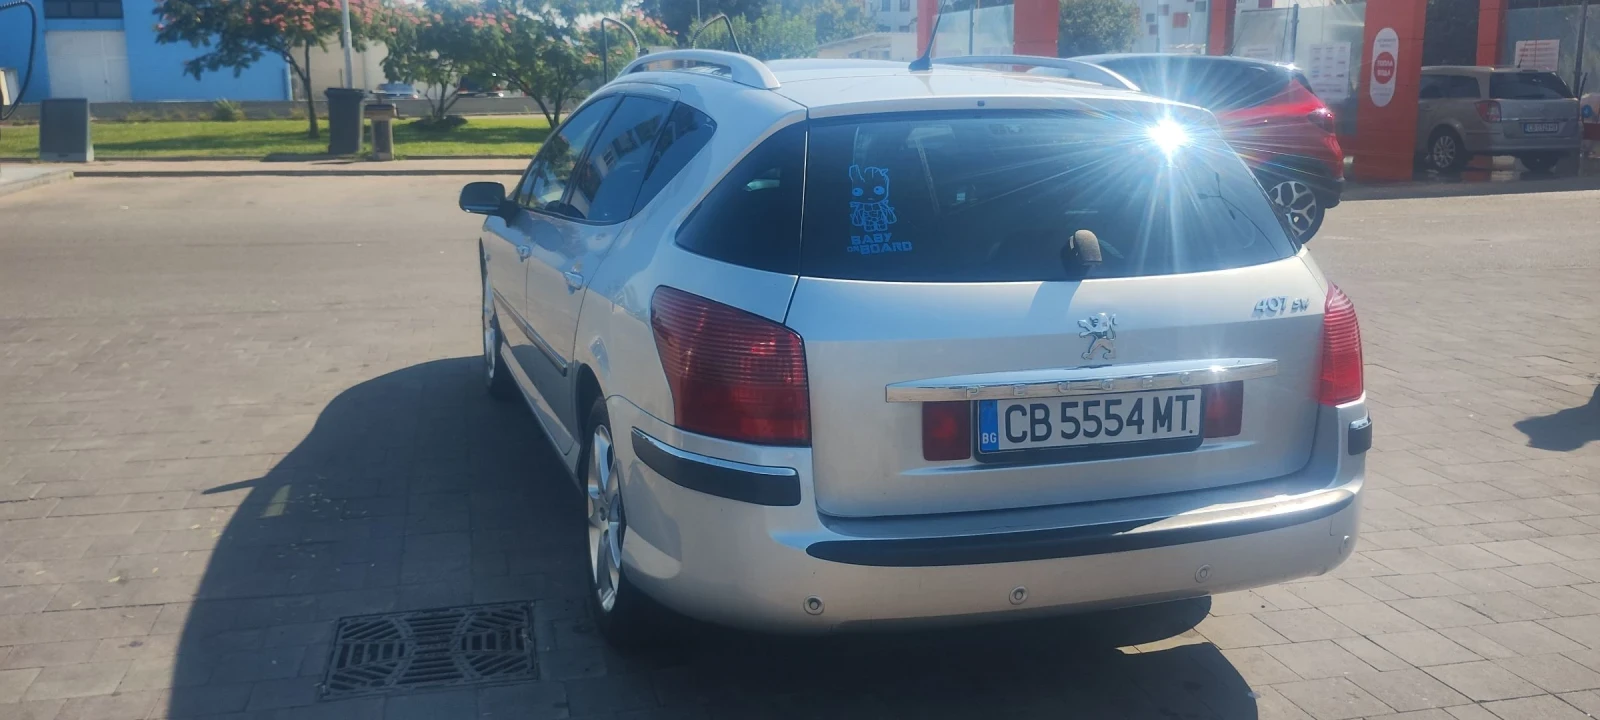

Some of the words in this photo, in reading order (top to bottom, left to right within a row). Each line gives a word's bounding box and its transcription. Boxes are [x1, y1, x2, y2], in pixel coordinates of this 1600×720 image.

[850, 232, 892, 245] BABY
[860, 241, 912, 255] BOARD
[1253, 296, 1288, 312] 407
[966, 370, 1228, 399] PEUGEO
[982, 432, 997, 444] BG
[1005, 403, 1052, 443] CB
[1060, 398, 1145, 440] 5554
[1152, 394, 1195, 434] MT
